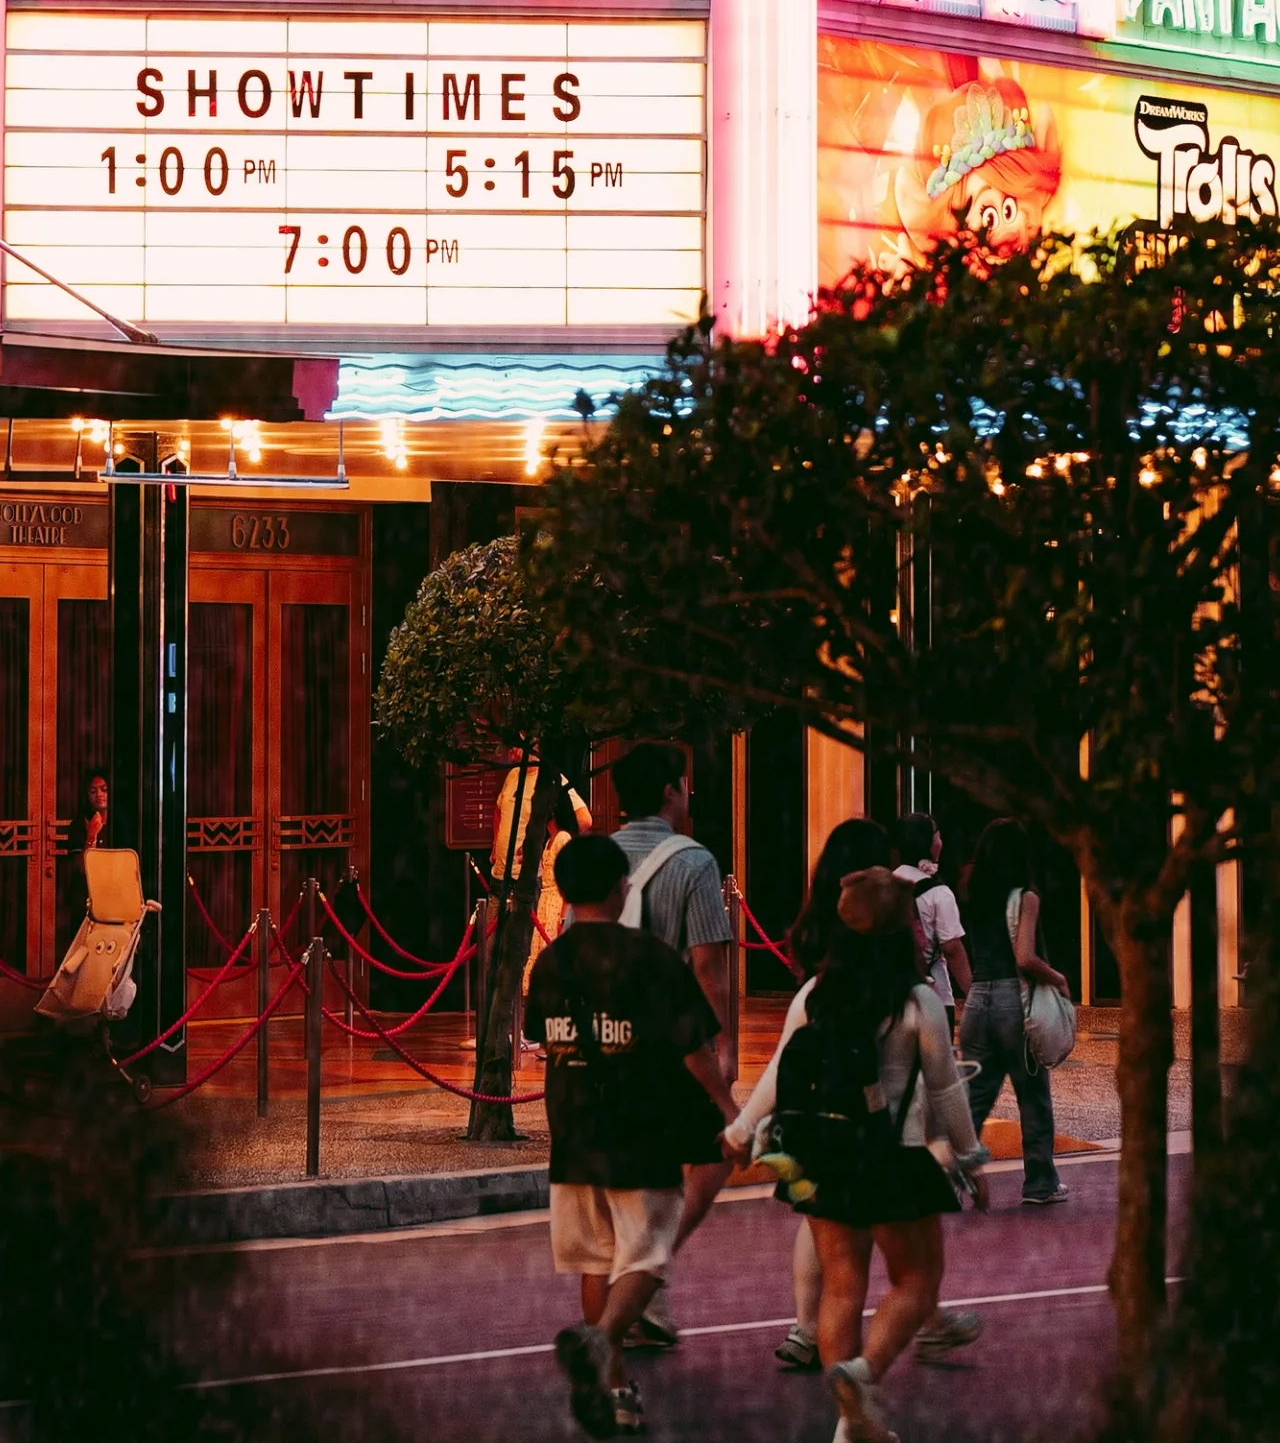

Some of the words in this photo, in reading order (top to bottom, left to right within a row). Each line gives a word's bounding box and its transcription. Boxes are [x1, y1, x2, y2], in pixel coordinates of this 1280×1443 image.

[135, 68, 582, 122] SHOWTIMES
[100, 146, 231, 197] 1:00
[242, 158, 277, 185] PM
[445, 149, 576, 199] 5:15
[589, 161, 624, 188] PM
[278, 225, 412, 276] 7:00
[425, 238, 460, 265] PM
[10, 525, 67, 545] THEATRE
[231, 514, 291, 549] 6233
[601, 1019, 632, 1045] BIG
